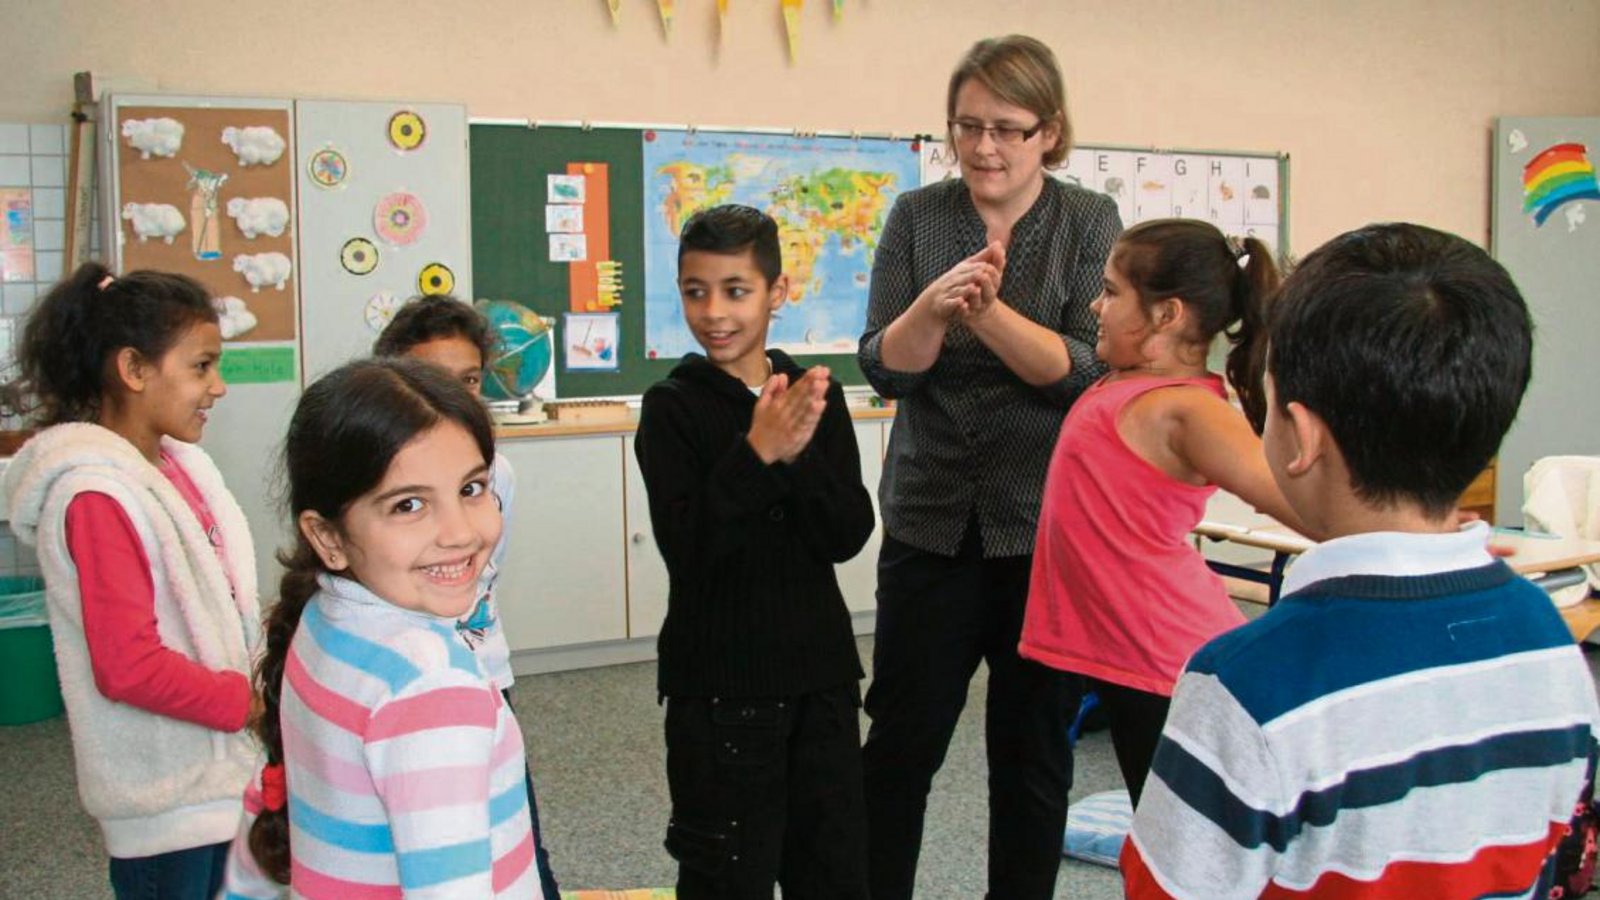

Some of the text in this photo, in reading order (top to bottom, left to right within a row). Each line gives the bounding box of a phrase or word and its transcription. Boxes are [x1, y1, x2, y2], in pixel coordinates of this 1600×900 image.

[930, 148, 941, 164] A
[1098, 155, 1108, 171] E
[1136, 157, 1147, 173] F
[1174, 159, 1187, 176] G
[1211, 161, 1222, 177] H
